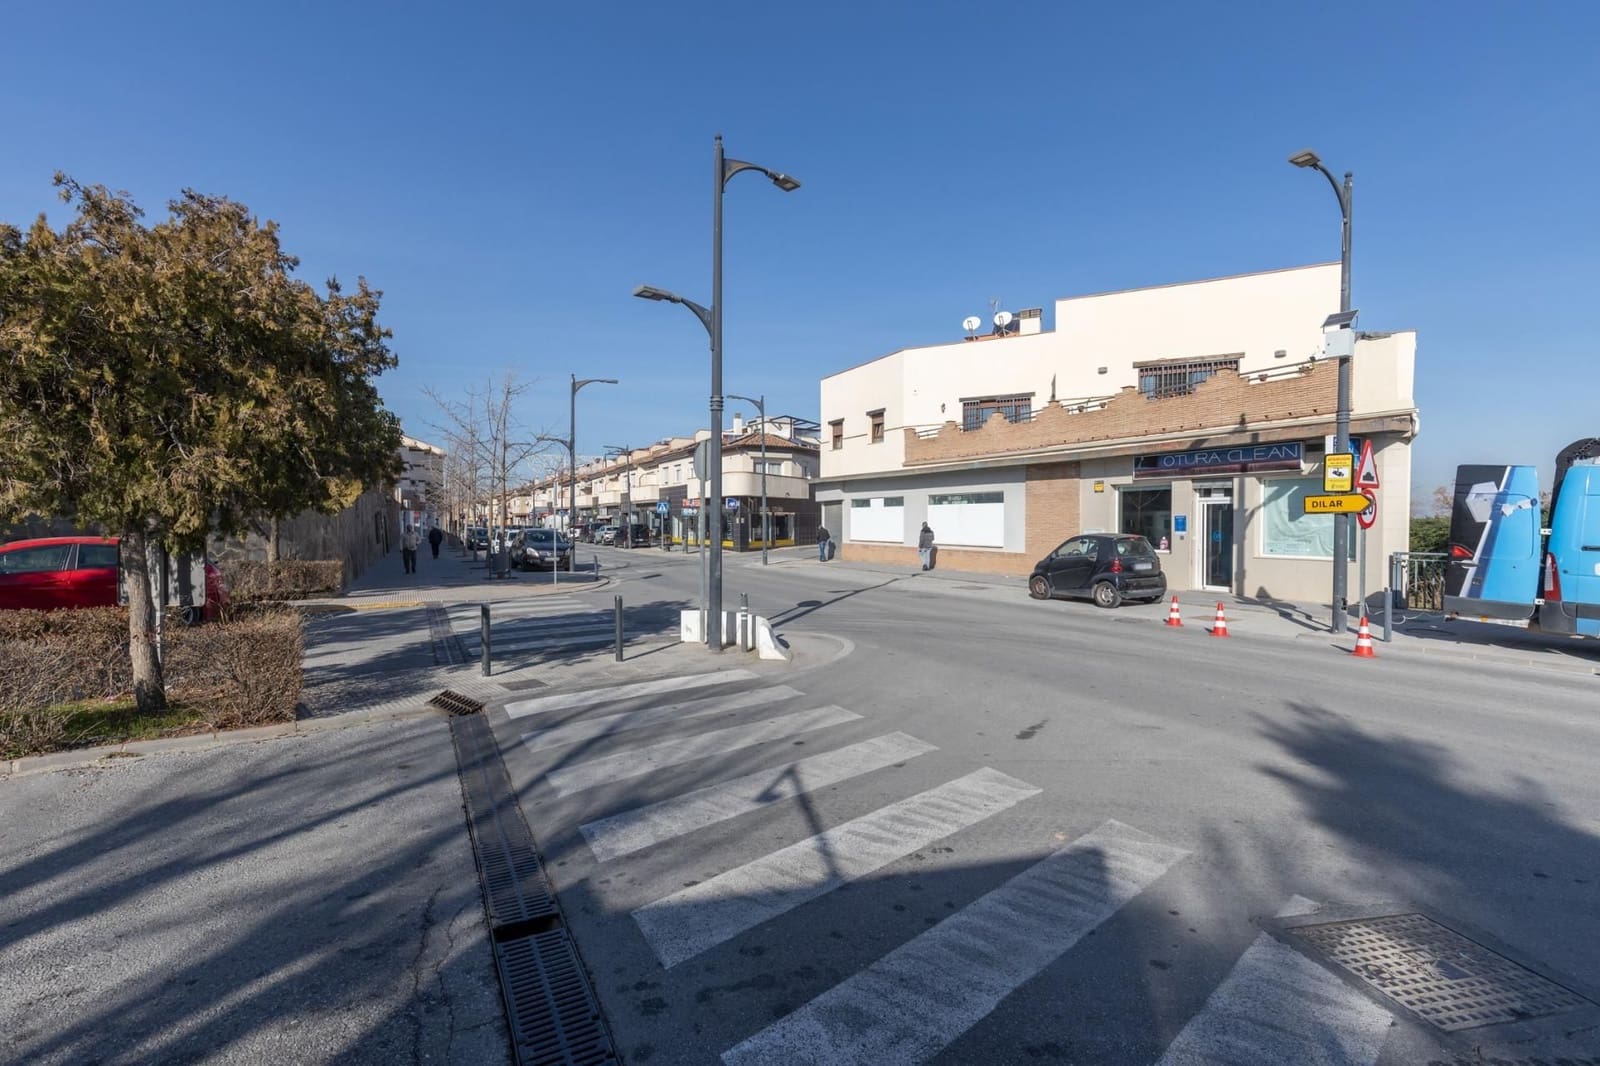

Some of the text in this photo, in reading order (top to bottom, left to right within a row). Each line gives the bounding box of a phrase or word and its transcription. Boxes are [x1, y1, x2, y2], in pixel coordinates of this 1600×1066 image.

[1163, 445, 1298, 467] OTURA CLEAN
[1311, 499, 1343, 508] DILAR
